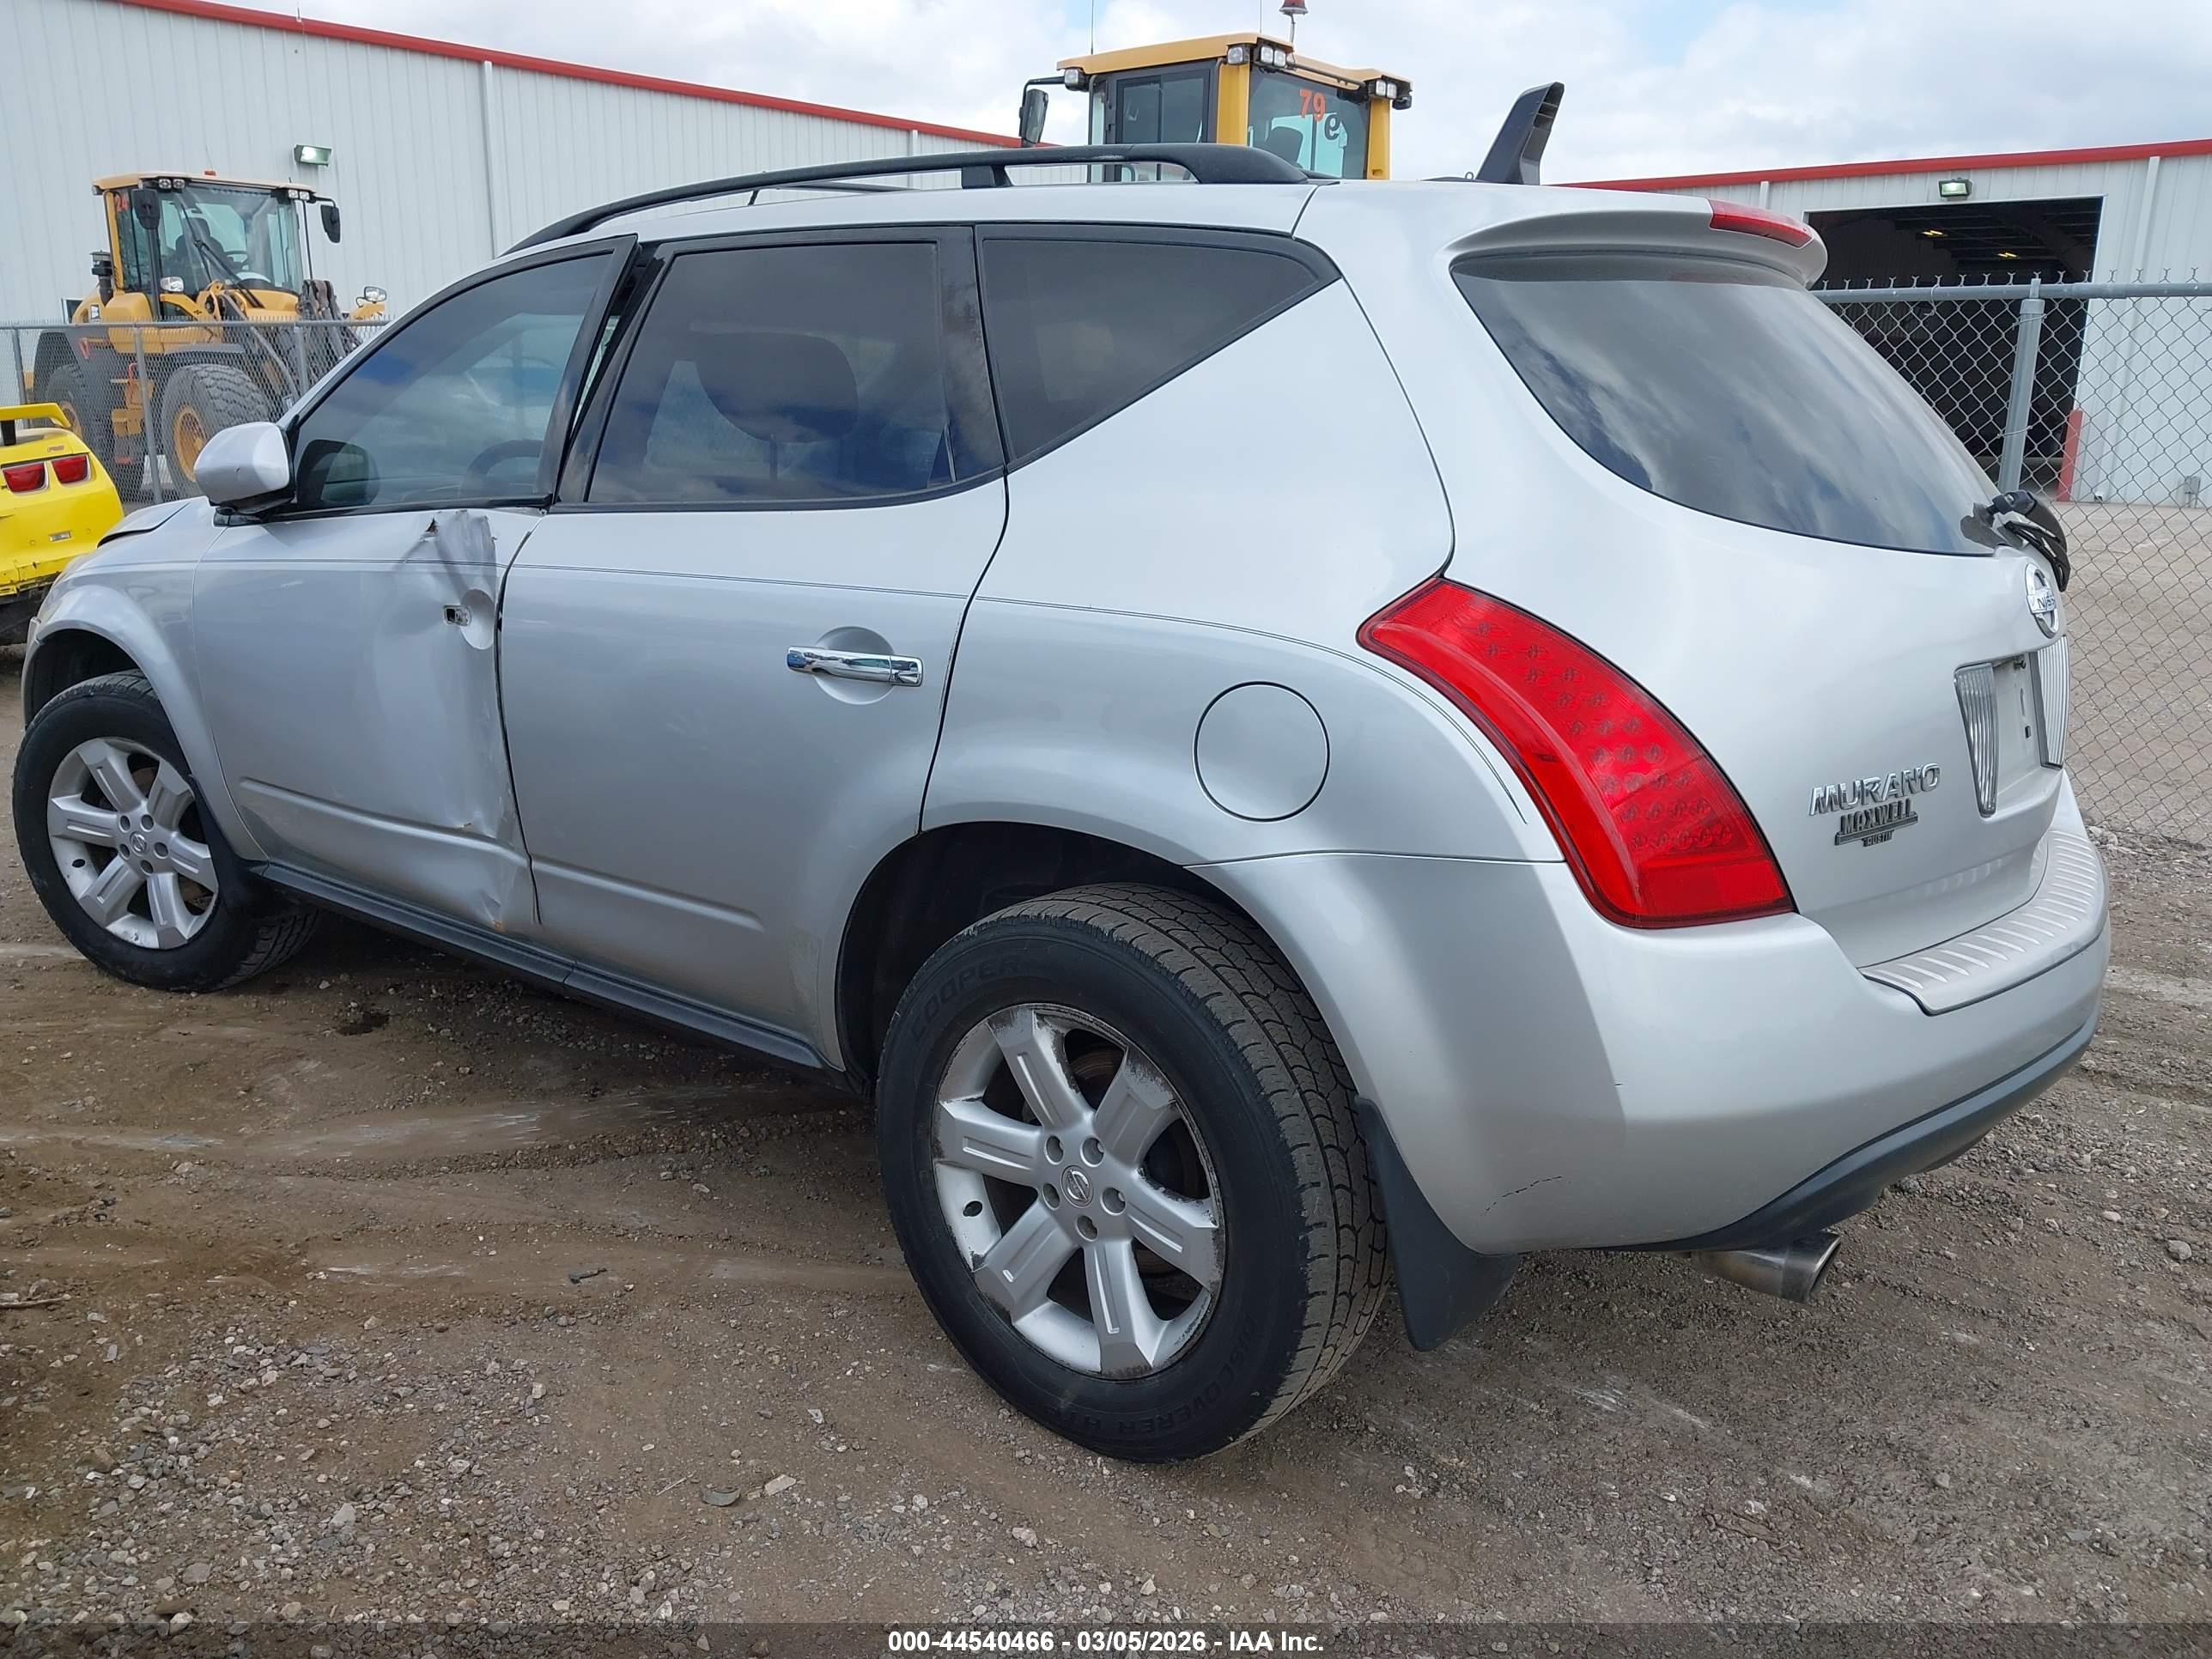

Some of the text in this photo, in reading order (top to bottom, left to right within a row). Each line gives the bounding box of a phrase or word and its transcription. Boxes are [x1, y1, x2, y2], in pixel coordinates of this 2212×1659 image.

[1299, 88, 1326, 122] 79
[1809, 763, 1941, 816] MURANO
[1840, 798, 1917, 835] MAXWELL
[910, 954, 1020, 1042] COOPER
[1119, 1314, 1256, 1436] DISCOVERER
